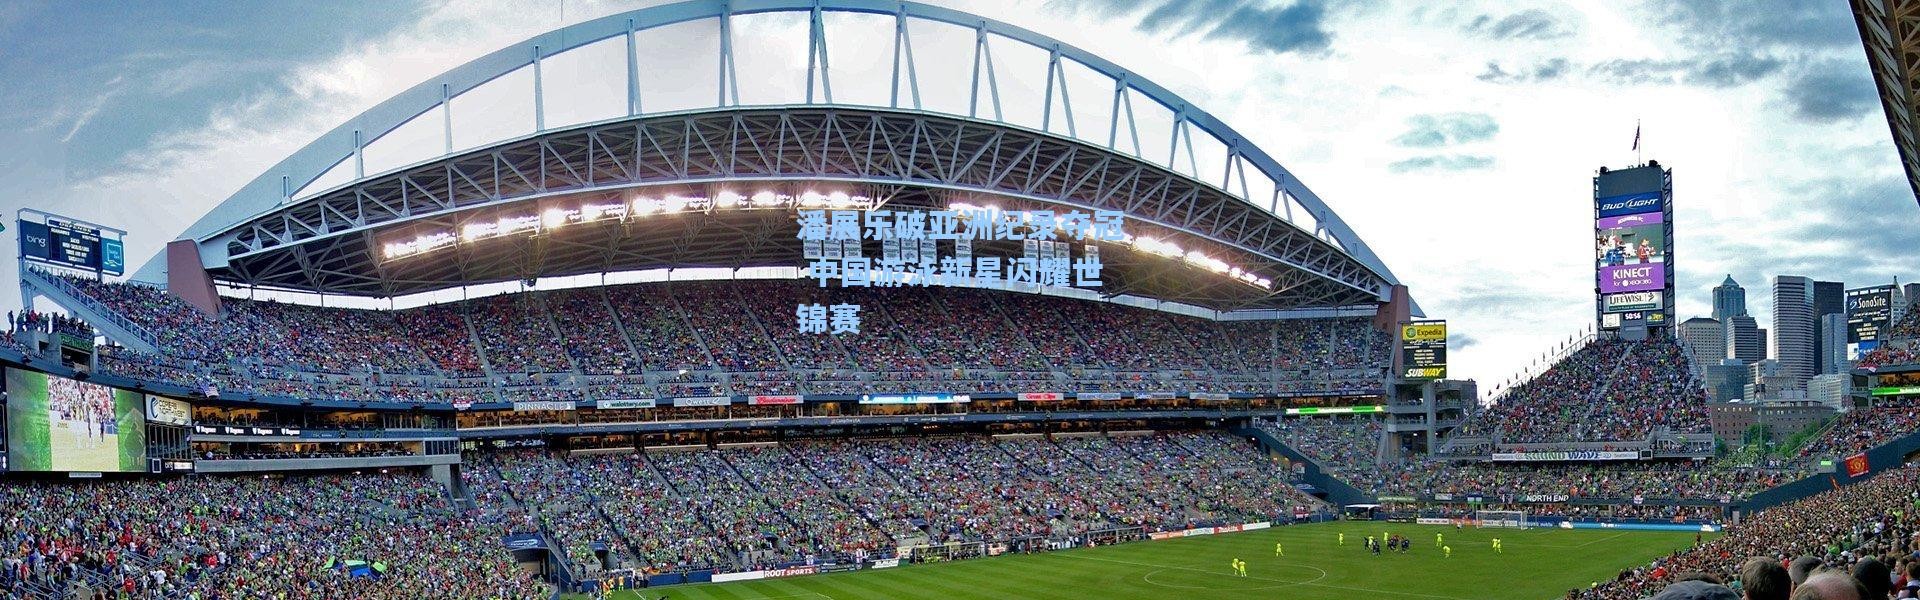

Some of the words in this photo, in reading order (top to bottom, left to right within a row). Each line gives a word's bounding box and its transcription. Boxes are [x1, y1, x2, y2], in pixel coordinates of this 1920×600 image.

[1601, 202, 1624, 210] BUD
[1628, 199, 1658, 207] LIGHT
[26, 235, 45, 247] bing
[1613, 267, 1652, 279] KINECT
[1858, 296, 1886, 308] SonoSite
[1417, 329, 1442, 337] Expedia
[1405, 368, 1444, 377] SUBWAY
[1526, 494, 1552, 503] NORTH
[1553, 494, 1570, 502] END
[765, 569, 786, 577] ROOT
